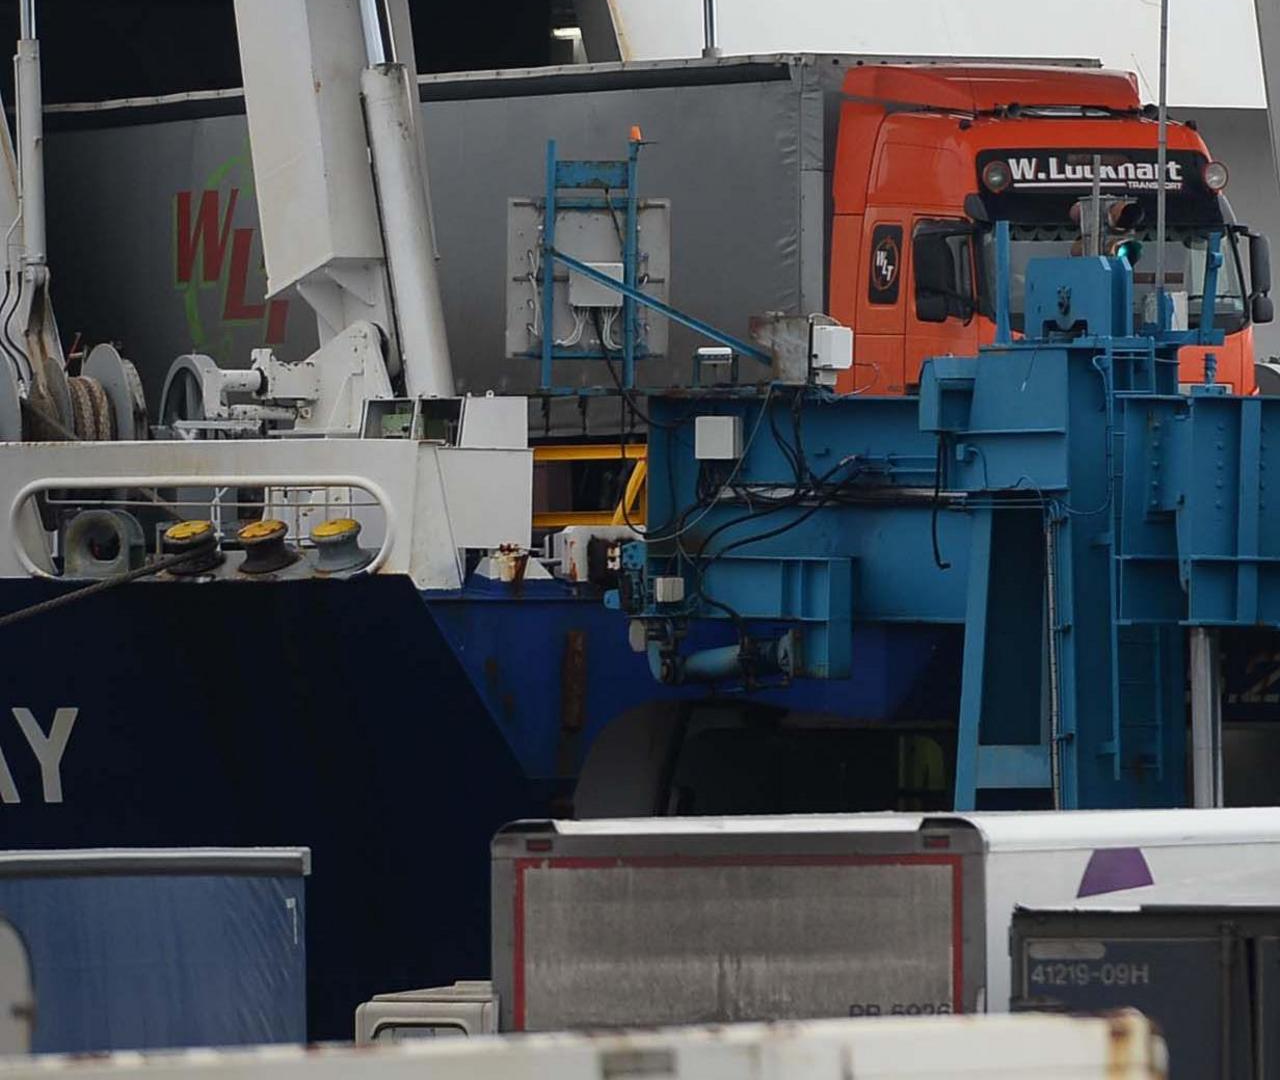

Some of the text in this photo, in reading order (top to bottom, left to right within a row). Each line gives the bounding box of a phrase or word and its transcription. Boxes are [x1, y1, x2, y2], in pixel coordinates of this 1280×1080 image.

[1127, 180, 1182, 190] TRANSORT
[876, 250, 895, 281] WLT
[1030, 962, 1149, 986] 41219-09H
